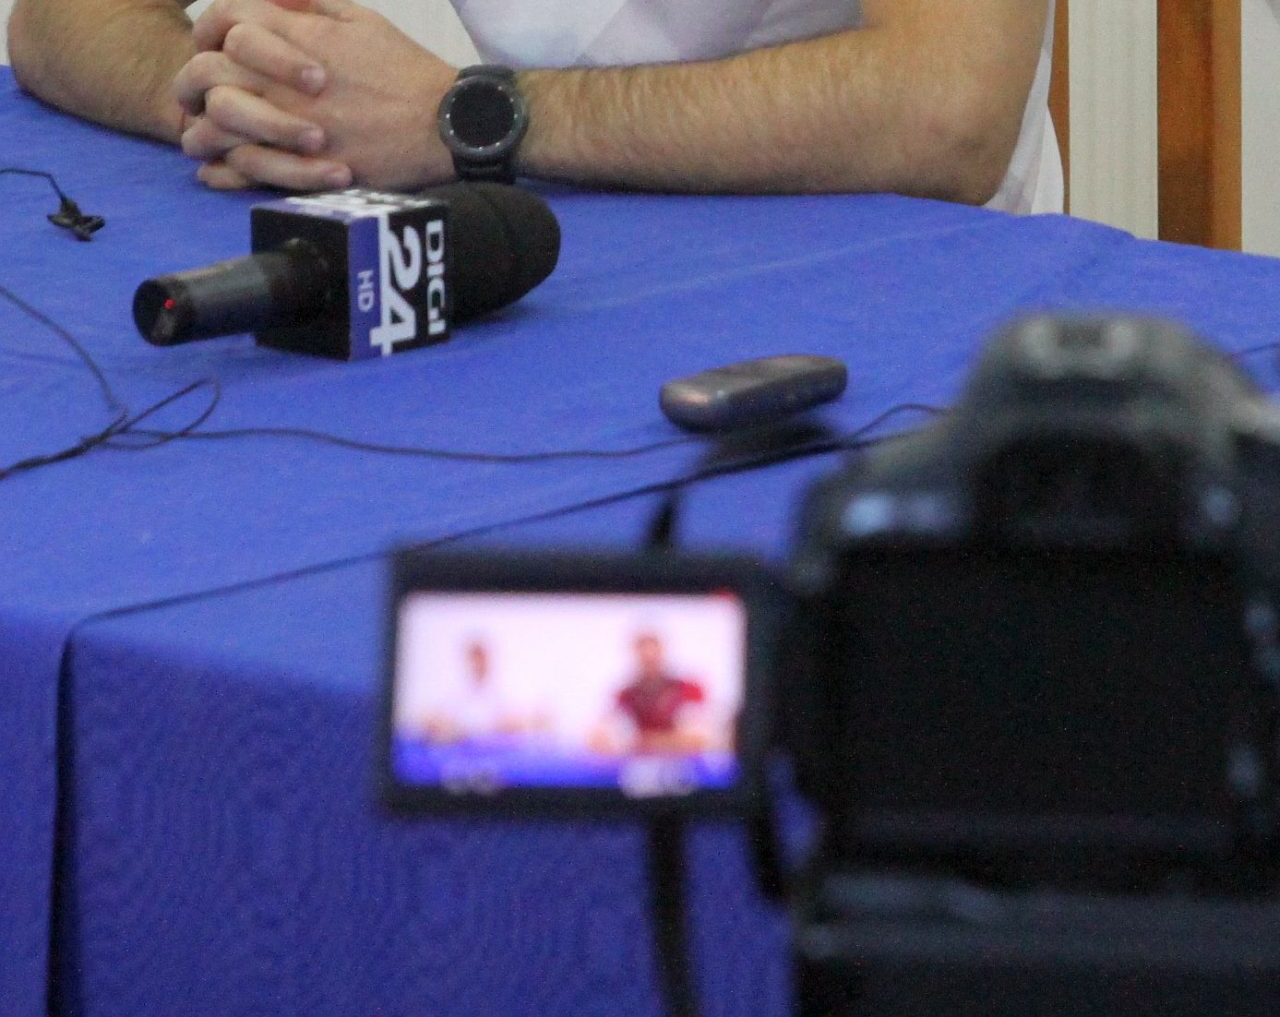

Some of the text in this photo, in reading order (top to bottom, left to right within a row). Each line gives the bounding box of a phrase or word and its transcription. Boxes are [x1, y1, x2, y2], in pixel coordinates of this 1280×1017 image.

[357, 269, 375, 313] HD
[369, 216, 422, 357] 24
[426, 219, 446, 334] DIGI
